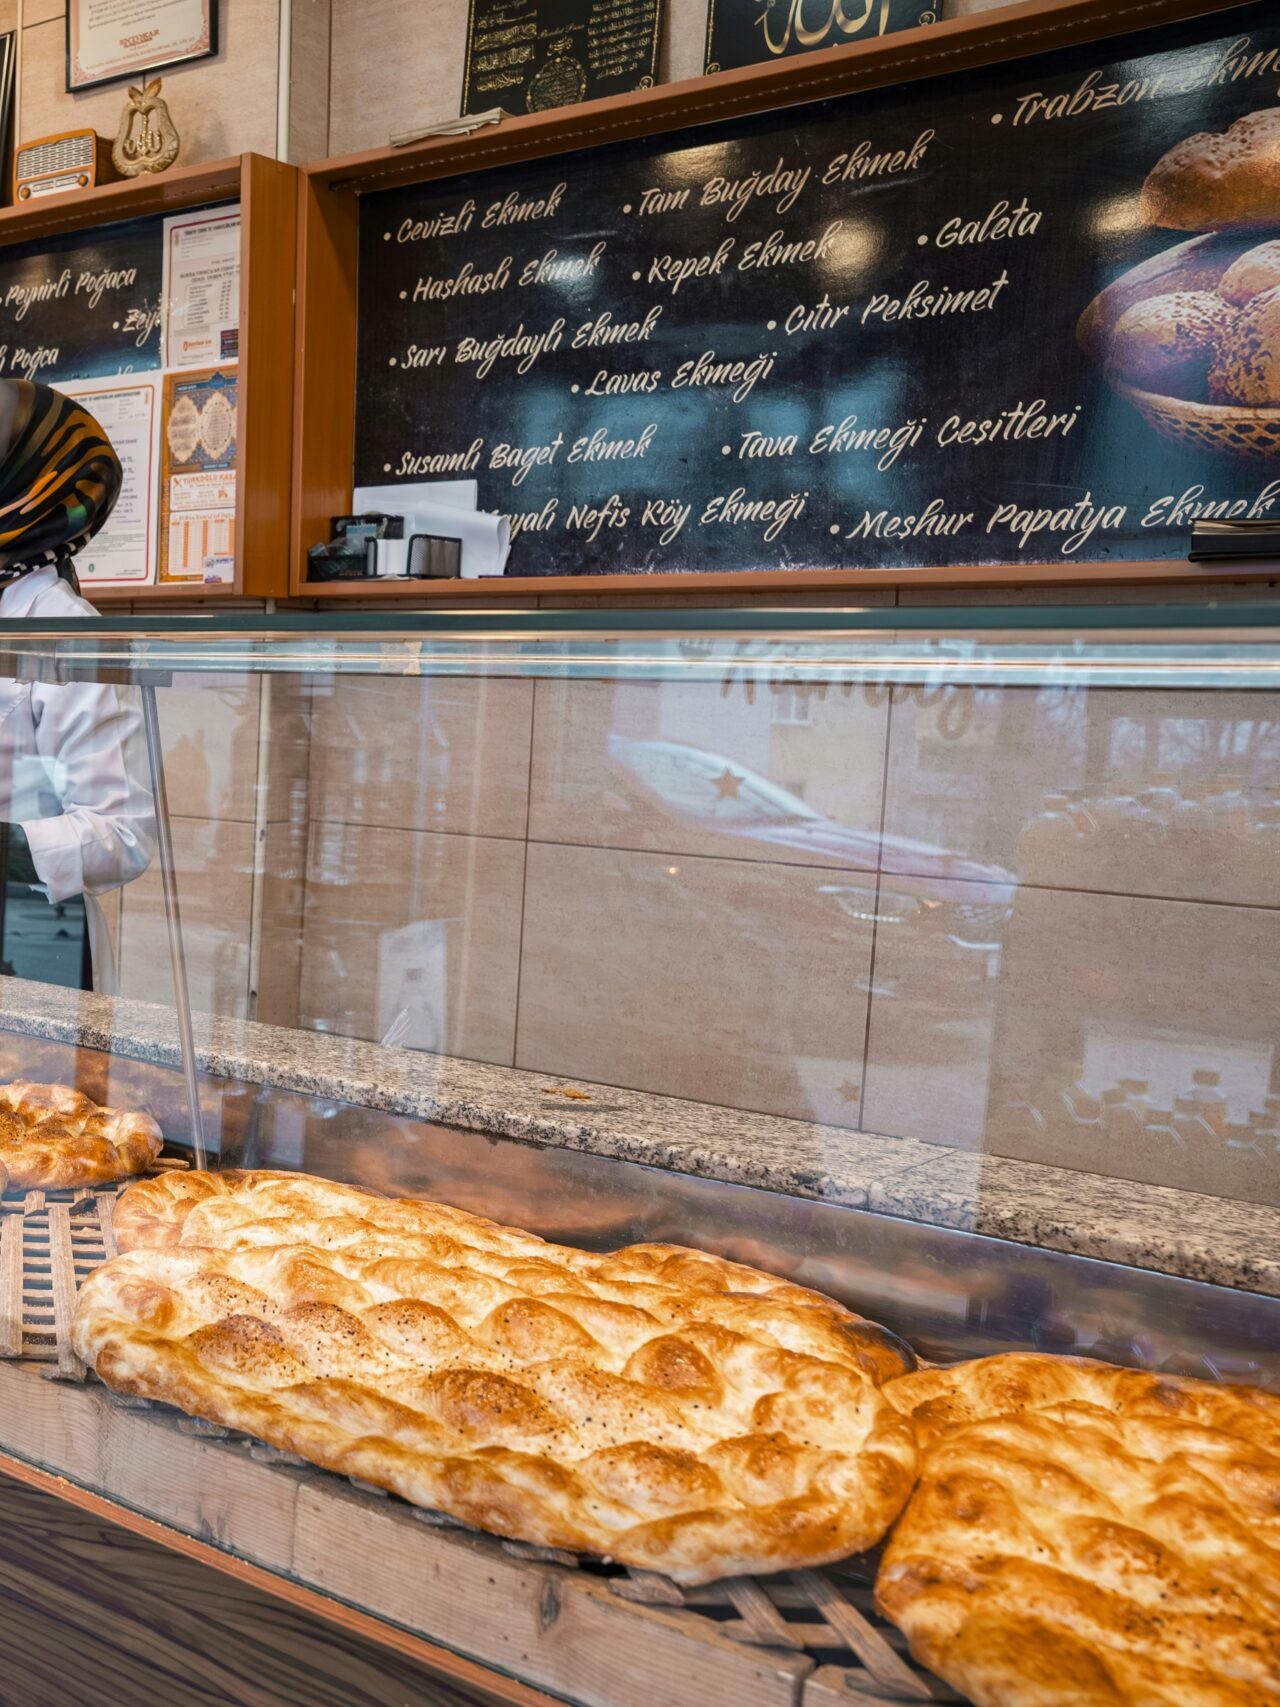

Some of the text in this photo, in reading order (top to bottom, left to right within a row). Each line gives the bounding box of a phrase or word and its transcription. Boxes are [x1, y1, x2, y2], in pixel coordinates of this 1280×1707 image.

[1012, 70, 1163, 126] Trabzon
[638, 129, 935, 222] Tam Buğday Ekmek
[397, 182, 567, 243] Cevizli Ekmek
[936, 198, 1042, 248] Galeta
[412, 241, 607, 302] Haşhaşlı Ekmek
[647, 221, 843, 294] Kepek Ekmek
[5, 269, 72, 321] Peynirli
[75, 267, 138, 309] Poğaça
[783, 270, 1009, 335] Çıtır Peksimet
[401, 305, 662, 379] Sarı Buğdaylı Ekmek
[585, 351, 778, 403] Lavaş Ekmeği
[395, 423, 658, 486] Susamlı Baget Ekmek
[739, 399, 1082, 471] Tava Ekmeği Çeşitleri
[566, 494, 631, 542] Nefis
[642, 500, 691, 545] Köy
[701, 487, 809, 542] Ekmeği
[845, 499, 974, 540] Meşhur
[986, 491, 1127, 554] Papatya
